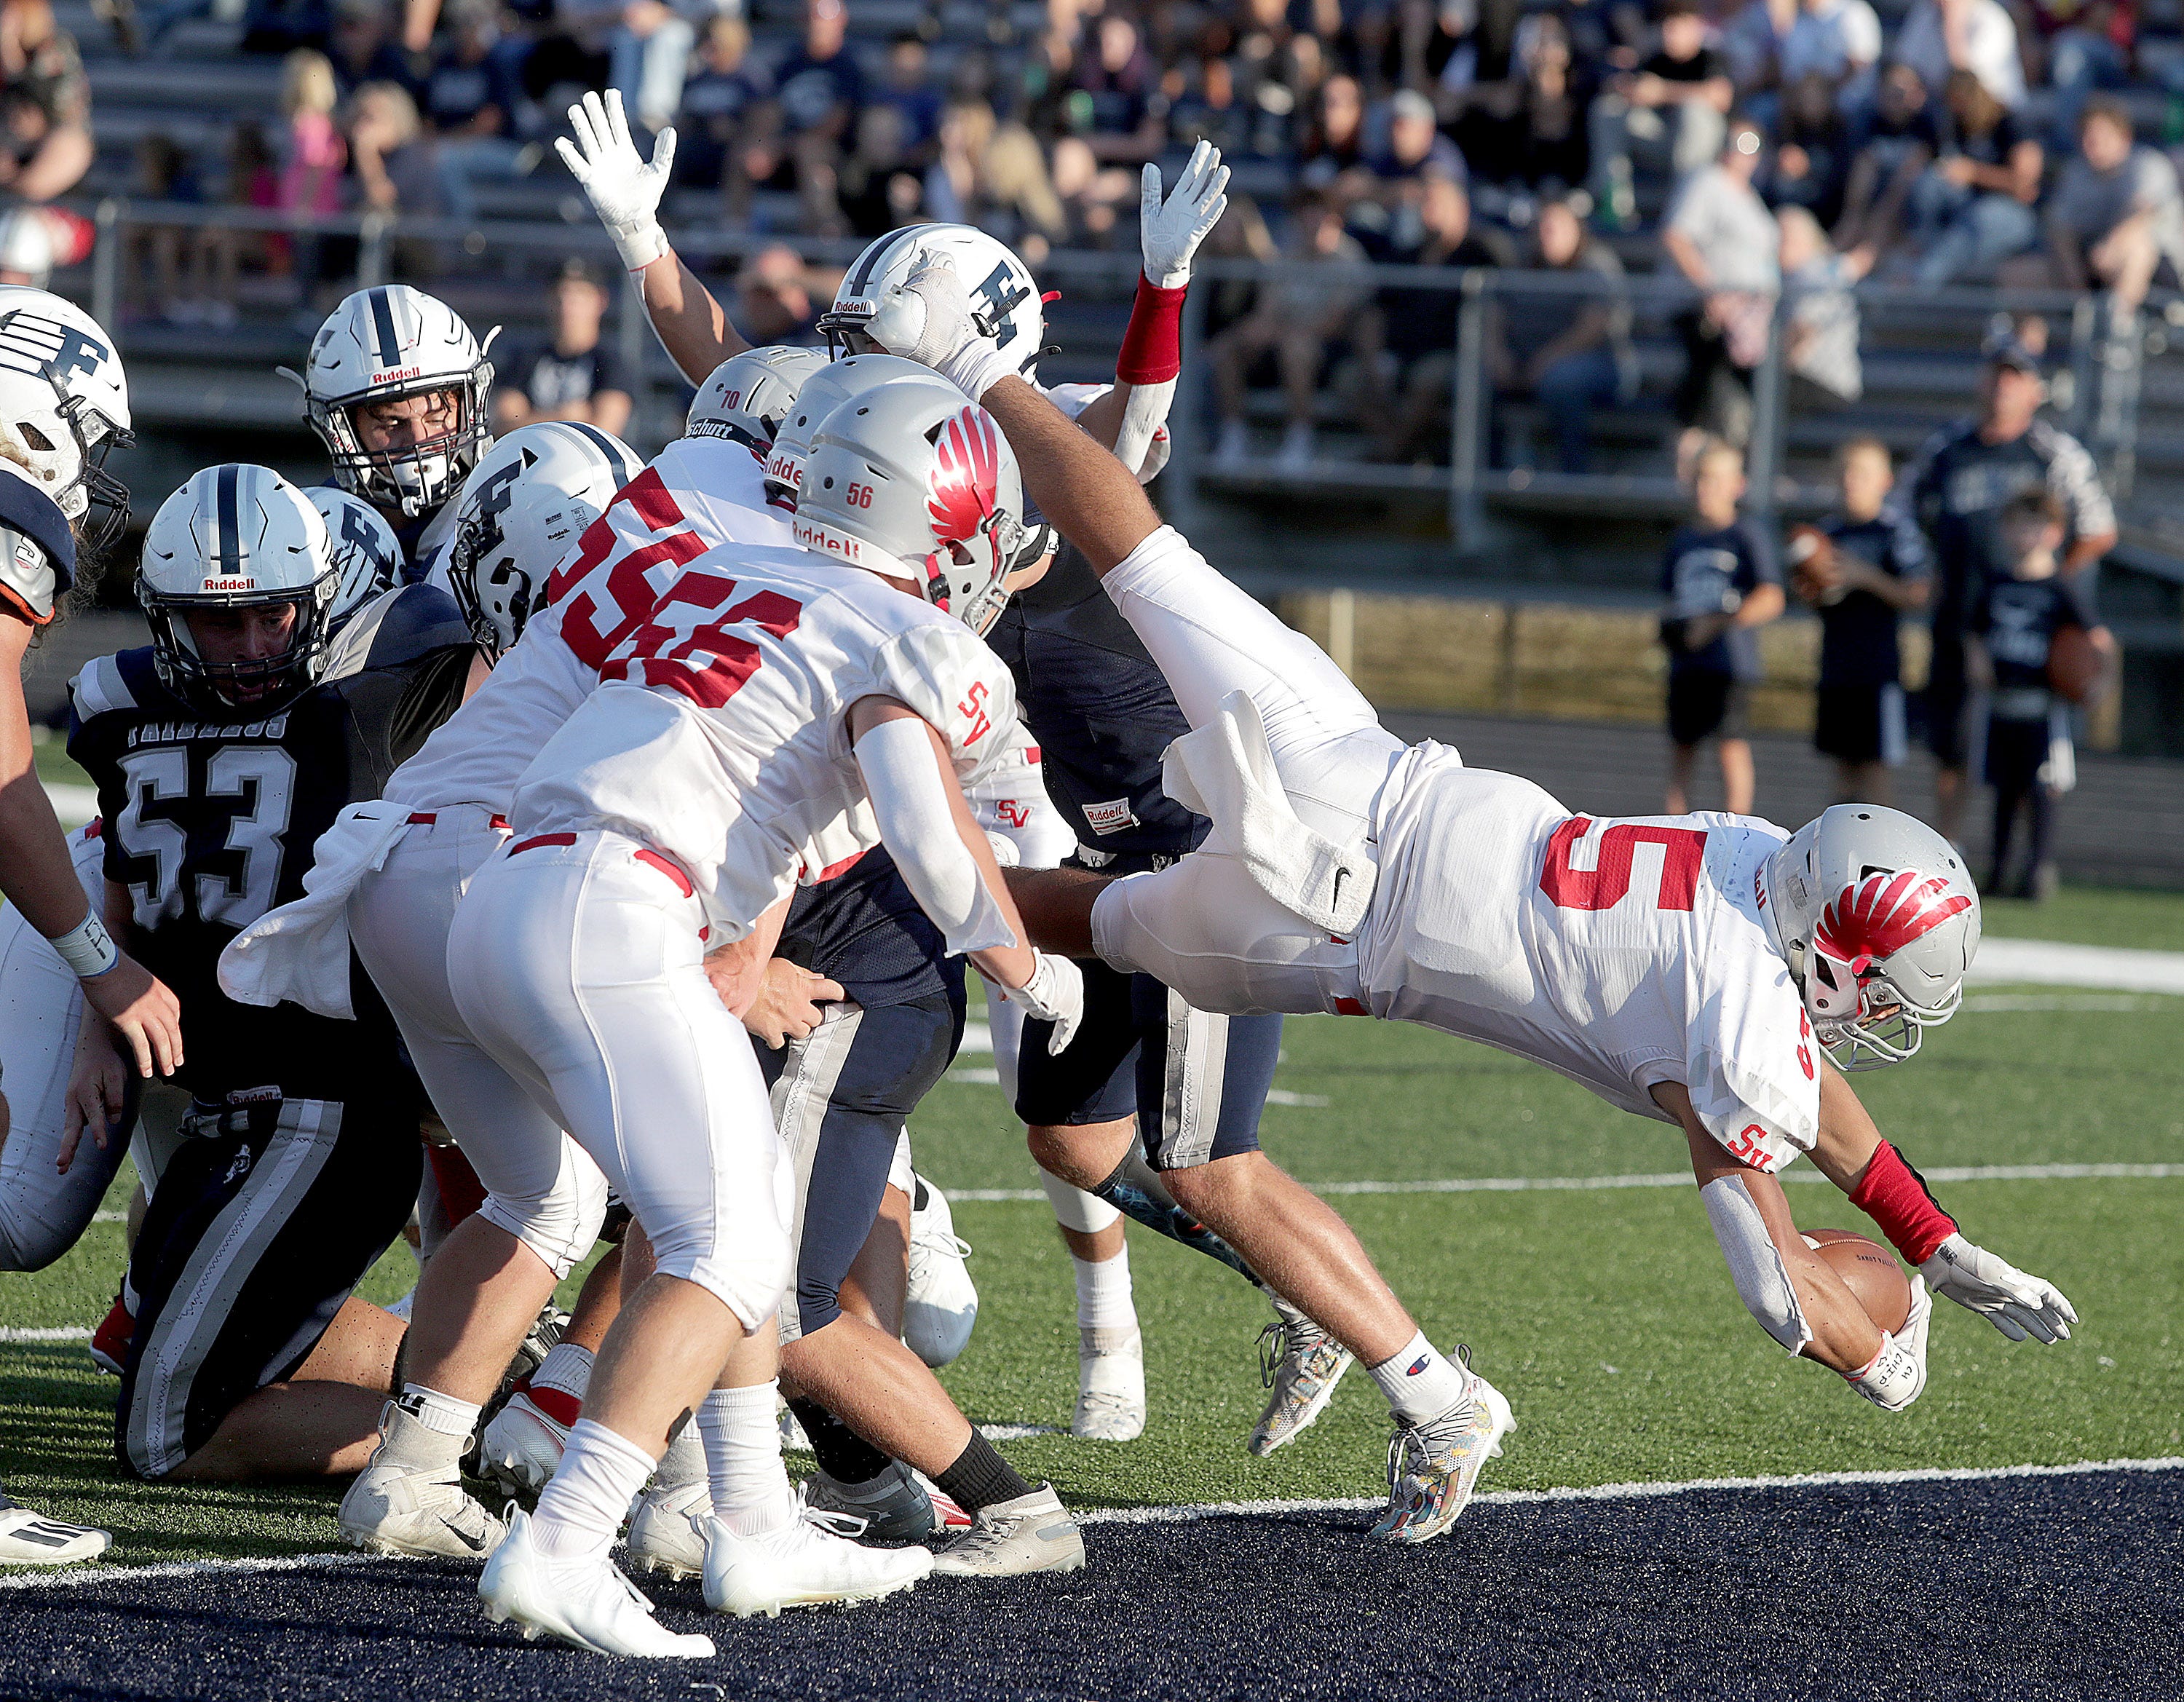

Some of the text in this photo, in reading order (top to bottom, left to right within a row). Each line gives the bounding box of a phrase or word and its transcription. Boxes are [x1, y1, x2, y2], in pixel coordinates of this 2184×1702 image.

[835, 301, 868, 312] Riddell
[373, 367, 420, 384] Riddell
[720, 389, 740, 410] 70
[847, 482, 874, 509] 56
[205, 578, 255, 590] Riddell
[599, 571, 804, 709] 56
[957, 681, 992, 748] SV
[994, 799, 1034, 828] SV
[1087, 804, 1125, 821] Riddell
[116, 745, 298, 930] 53
[1538, 816, 1709, 911] 5
[1726, 1123, 1773, 1168] SV
